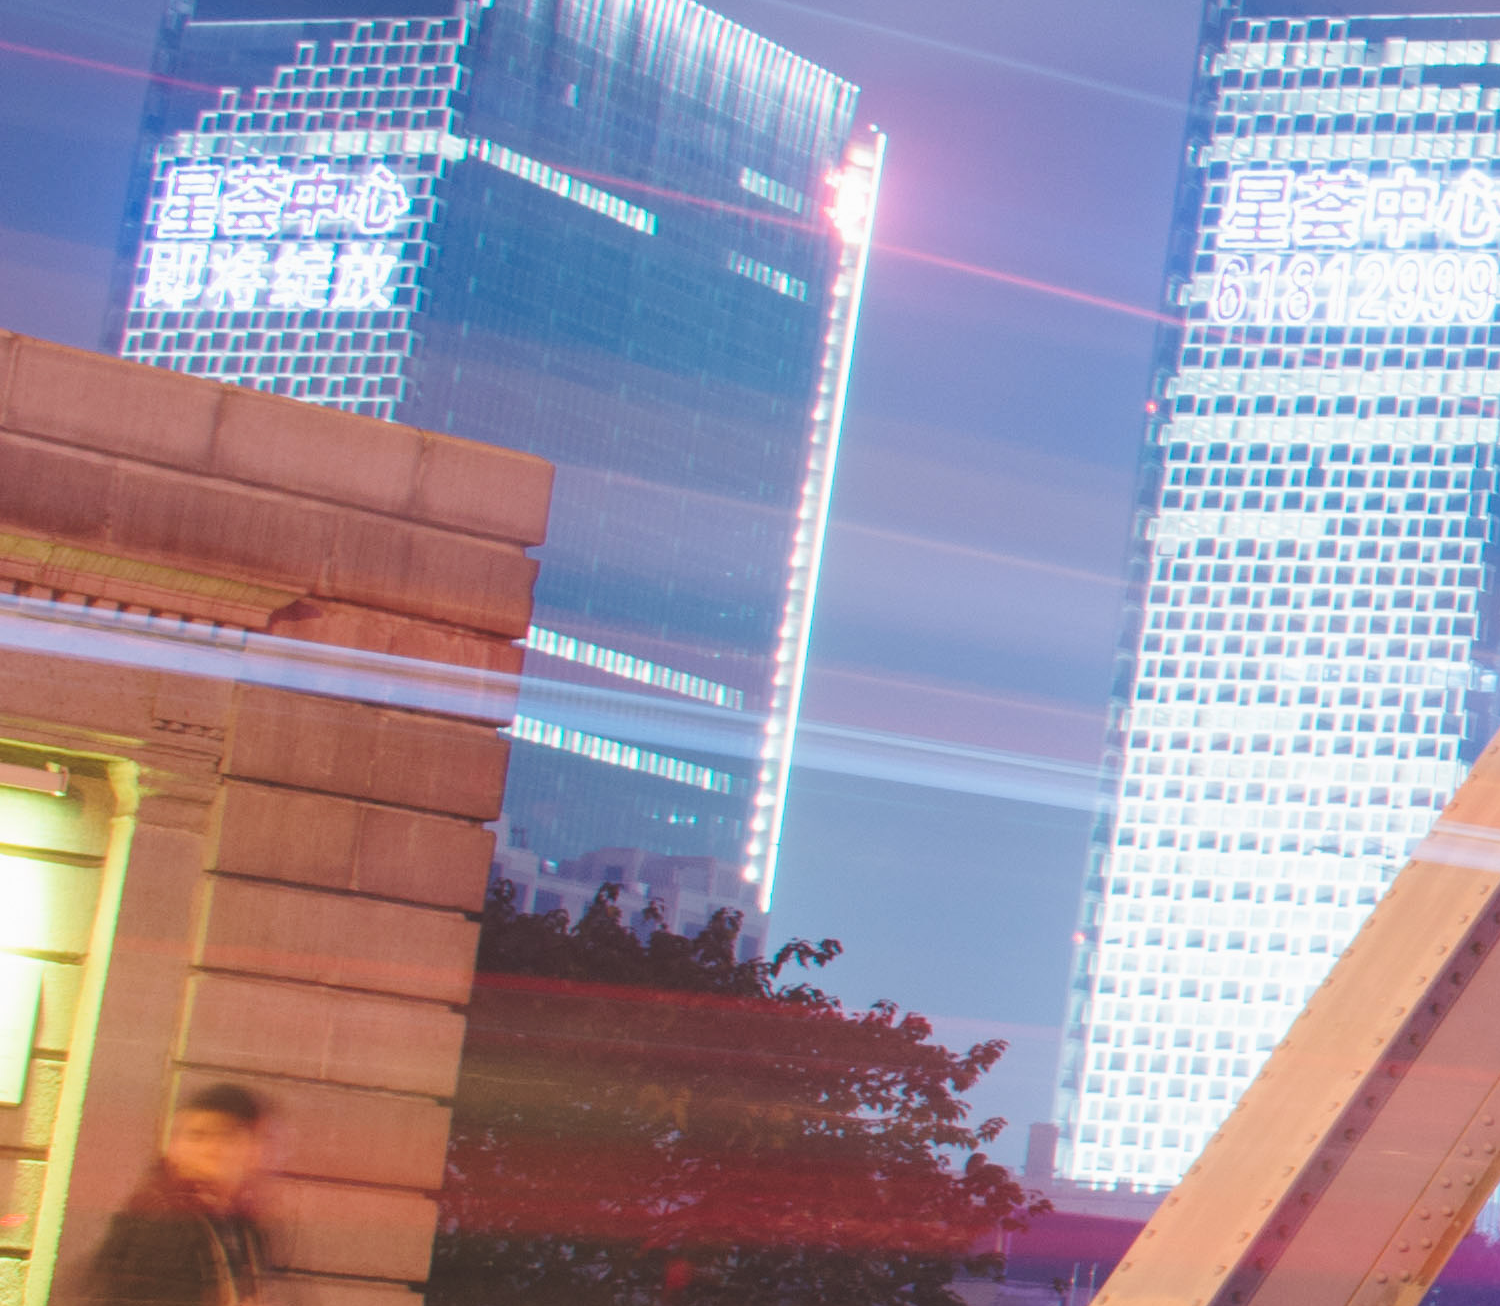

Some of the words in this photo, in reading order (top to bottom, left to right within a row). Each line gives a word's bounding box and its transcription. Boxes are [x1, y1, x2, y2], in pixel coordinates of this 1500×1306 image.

[156, 163, 412, 239] 星荟中心
[142, 242, 399, 310] 即将绽放
[1210, 253, 1499, 325] 61812999
